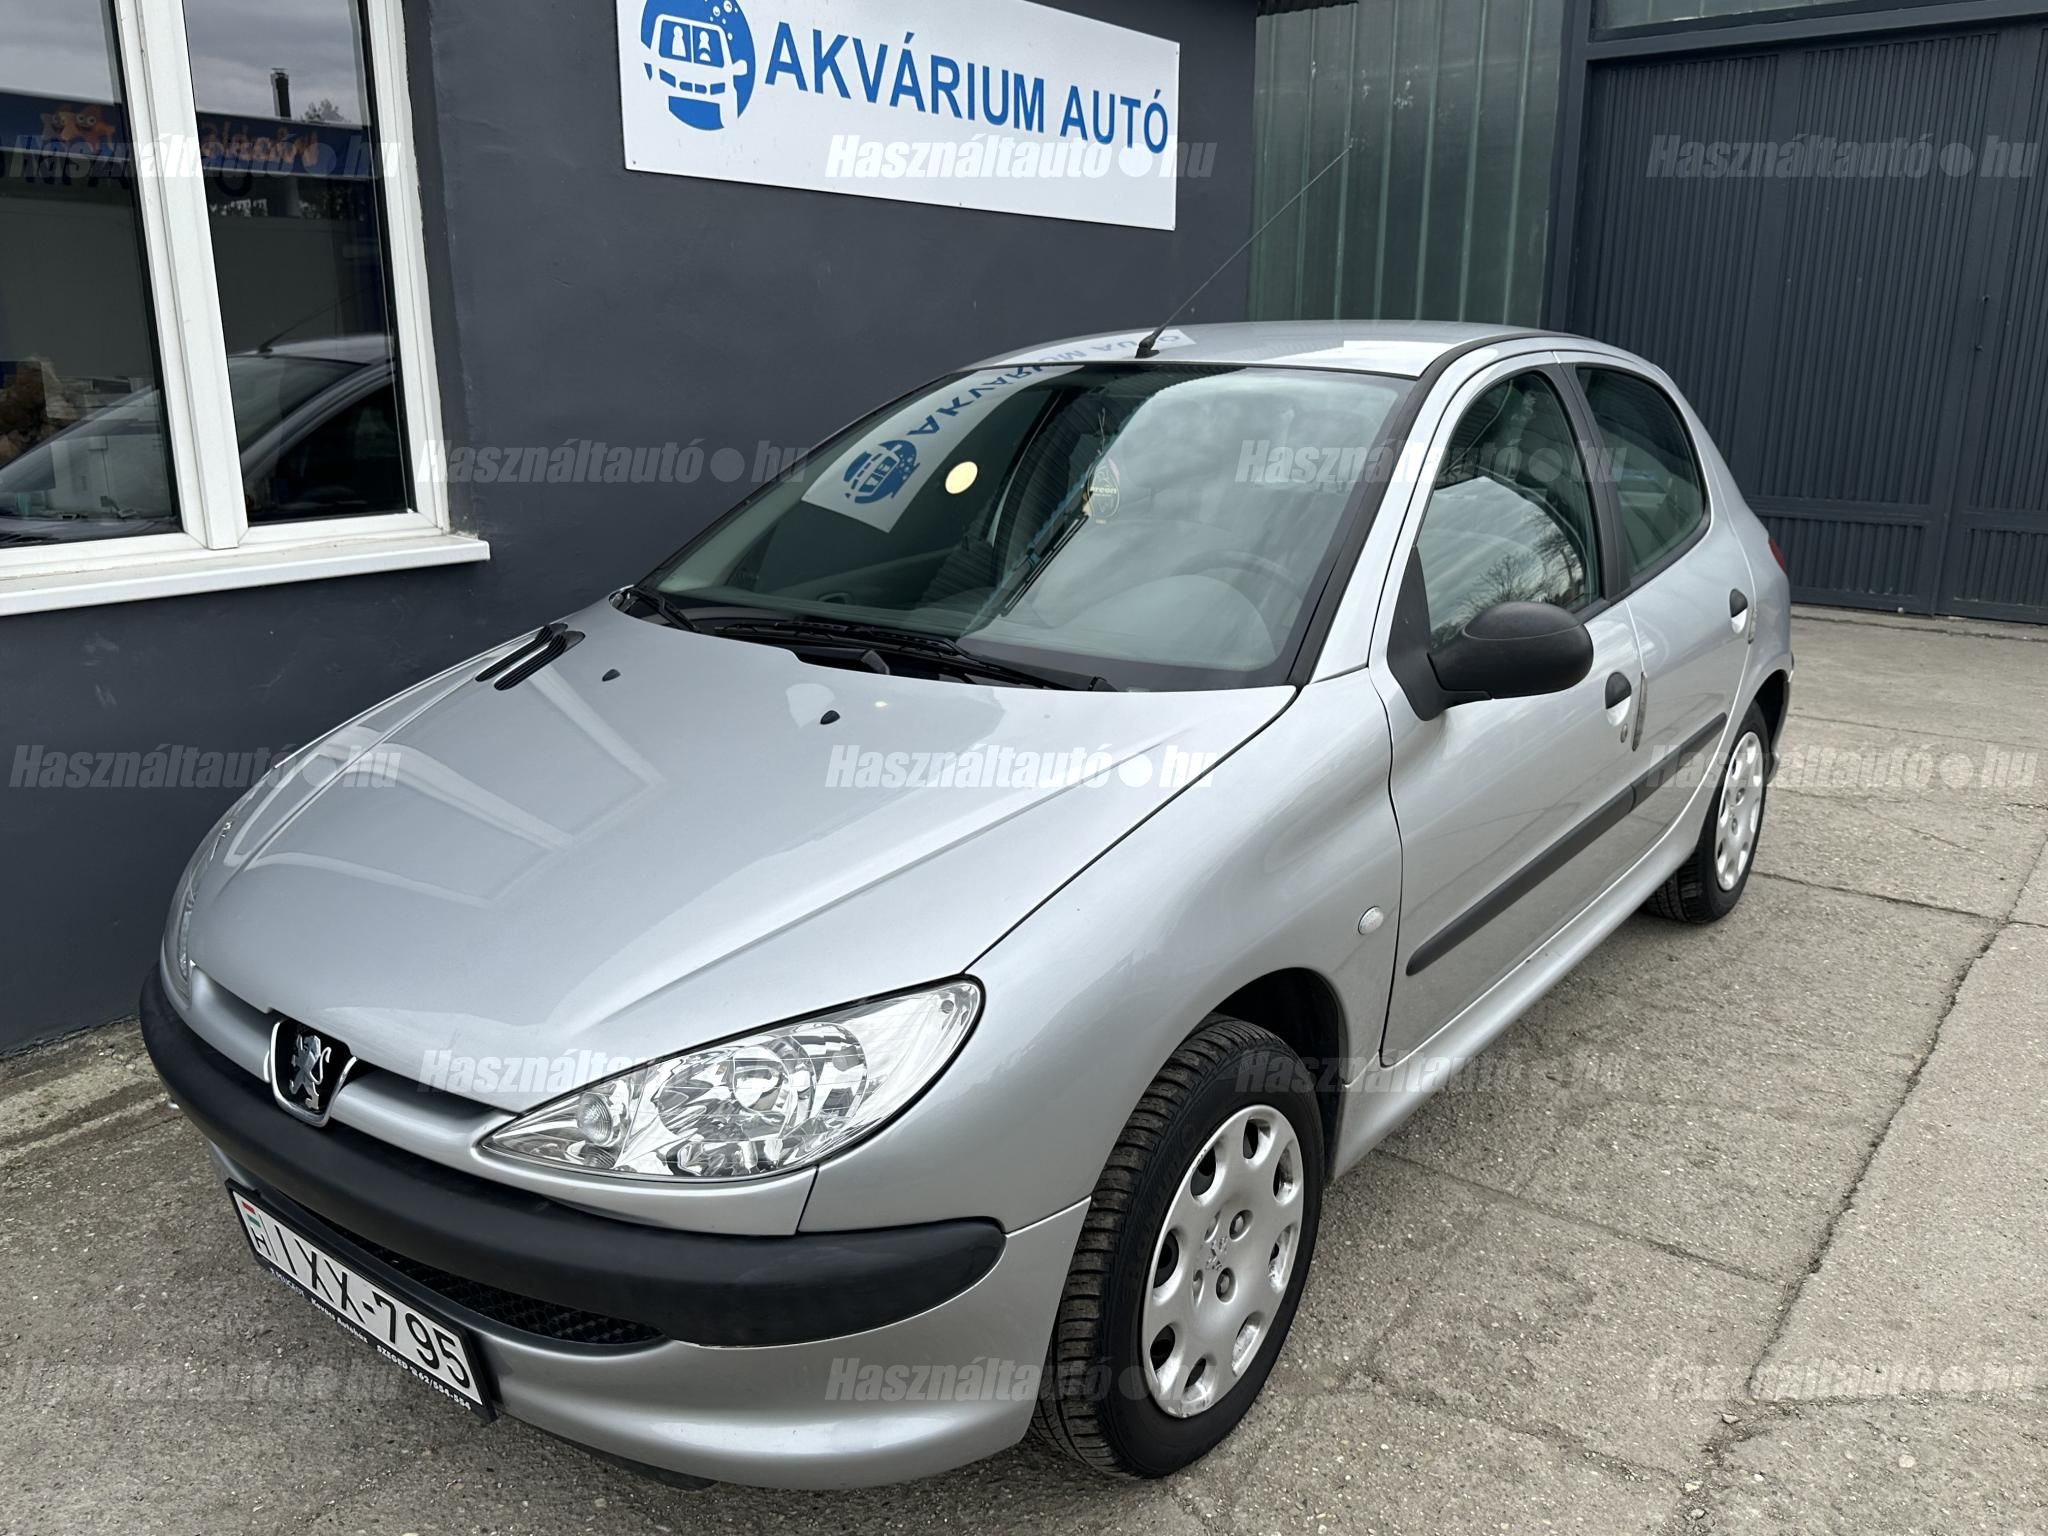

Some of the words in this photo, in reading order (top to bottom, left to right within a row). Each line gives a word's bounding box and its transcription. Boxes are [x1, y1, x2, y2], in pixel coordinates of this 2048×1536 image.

[765, 22, 1044, 133] AKVÁRIUM
[1059, 89, 1168, 154] AUTÓ
[251, 1227, 271, 1257] H
[275, 1224, 470, 1389] IXX-795
[376, 1344, 408, 1370] SZEGED
